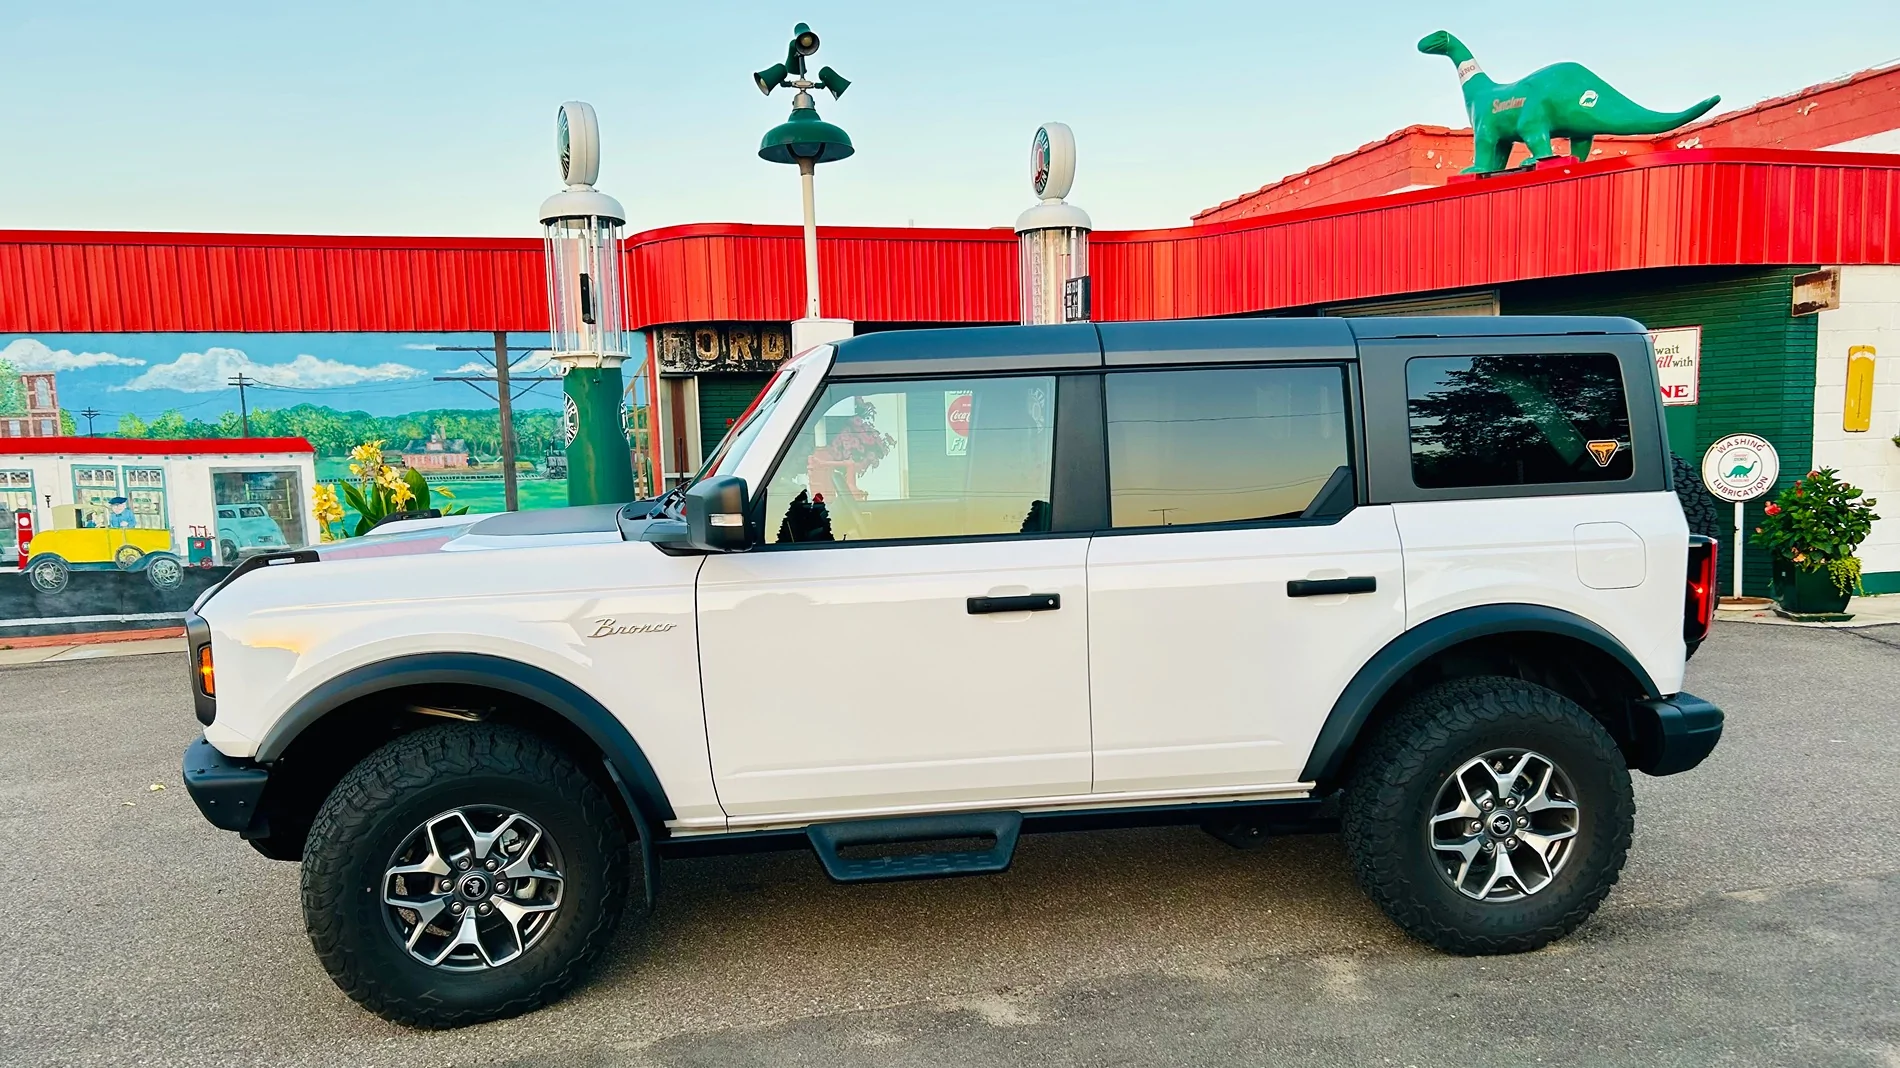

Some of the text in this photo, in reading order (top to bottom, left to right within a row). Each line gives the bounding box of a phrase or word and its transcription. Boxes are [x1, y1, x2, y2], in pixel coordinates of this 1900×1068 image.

[662, 327, 786, 361] FORD
[1655, 345, 1680, 355] wait
[1672, 356, 1693, 367] with
[1716, 438, 1765, 454] WASHING
[1712, 475, 1769, 498] LUBRICATION
[587, 618, 678, 639] Bronco
